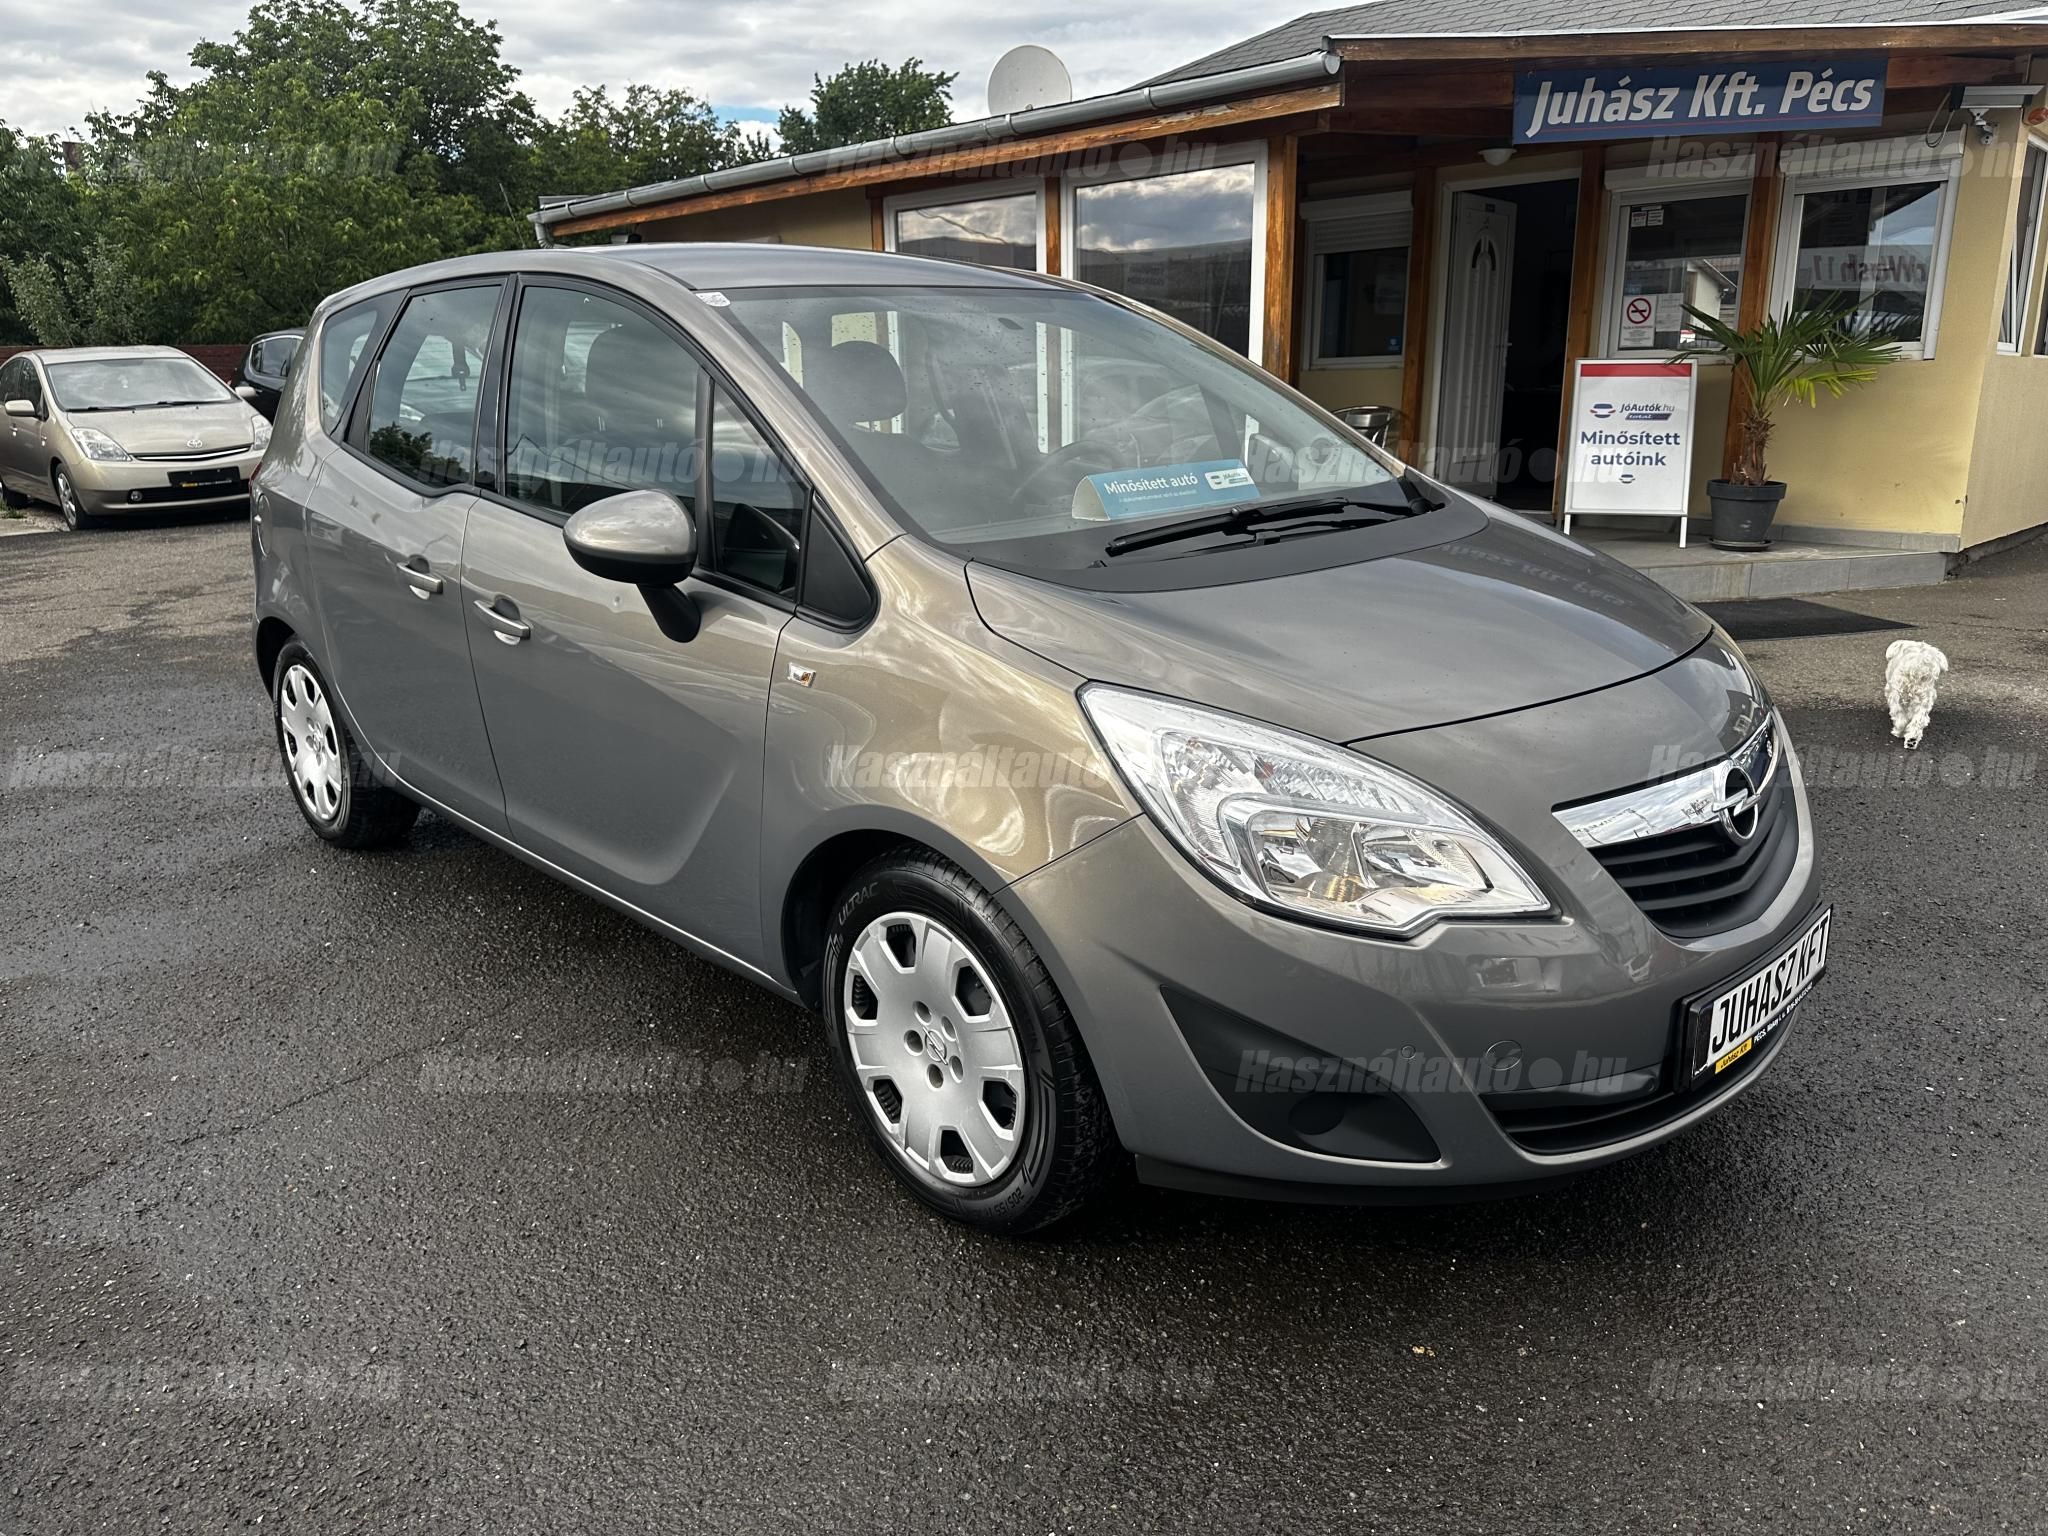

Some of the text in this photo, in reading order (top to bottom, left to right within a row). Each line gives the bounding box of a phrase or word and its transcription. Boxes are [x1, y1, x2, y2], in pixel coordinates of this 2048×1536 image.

[1525, 68, 1875, 138] Juhász Kft. Pécs
[1581, 430, 1680, 445] Minősített
[1591, 451, 1666, 466] autóink
[1104, 472, 1198, 495] Minősített autó
[838, 881, 879, 927] ULTRAC
[1712, 948, 1797, 1053] JUHASZ
[1796, 915, 1828, 987] KFT
